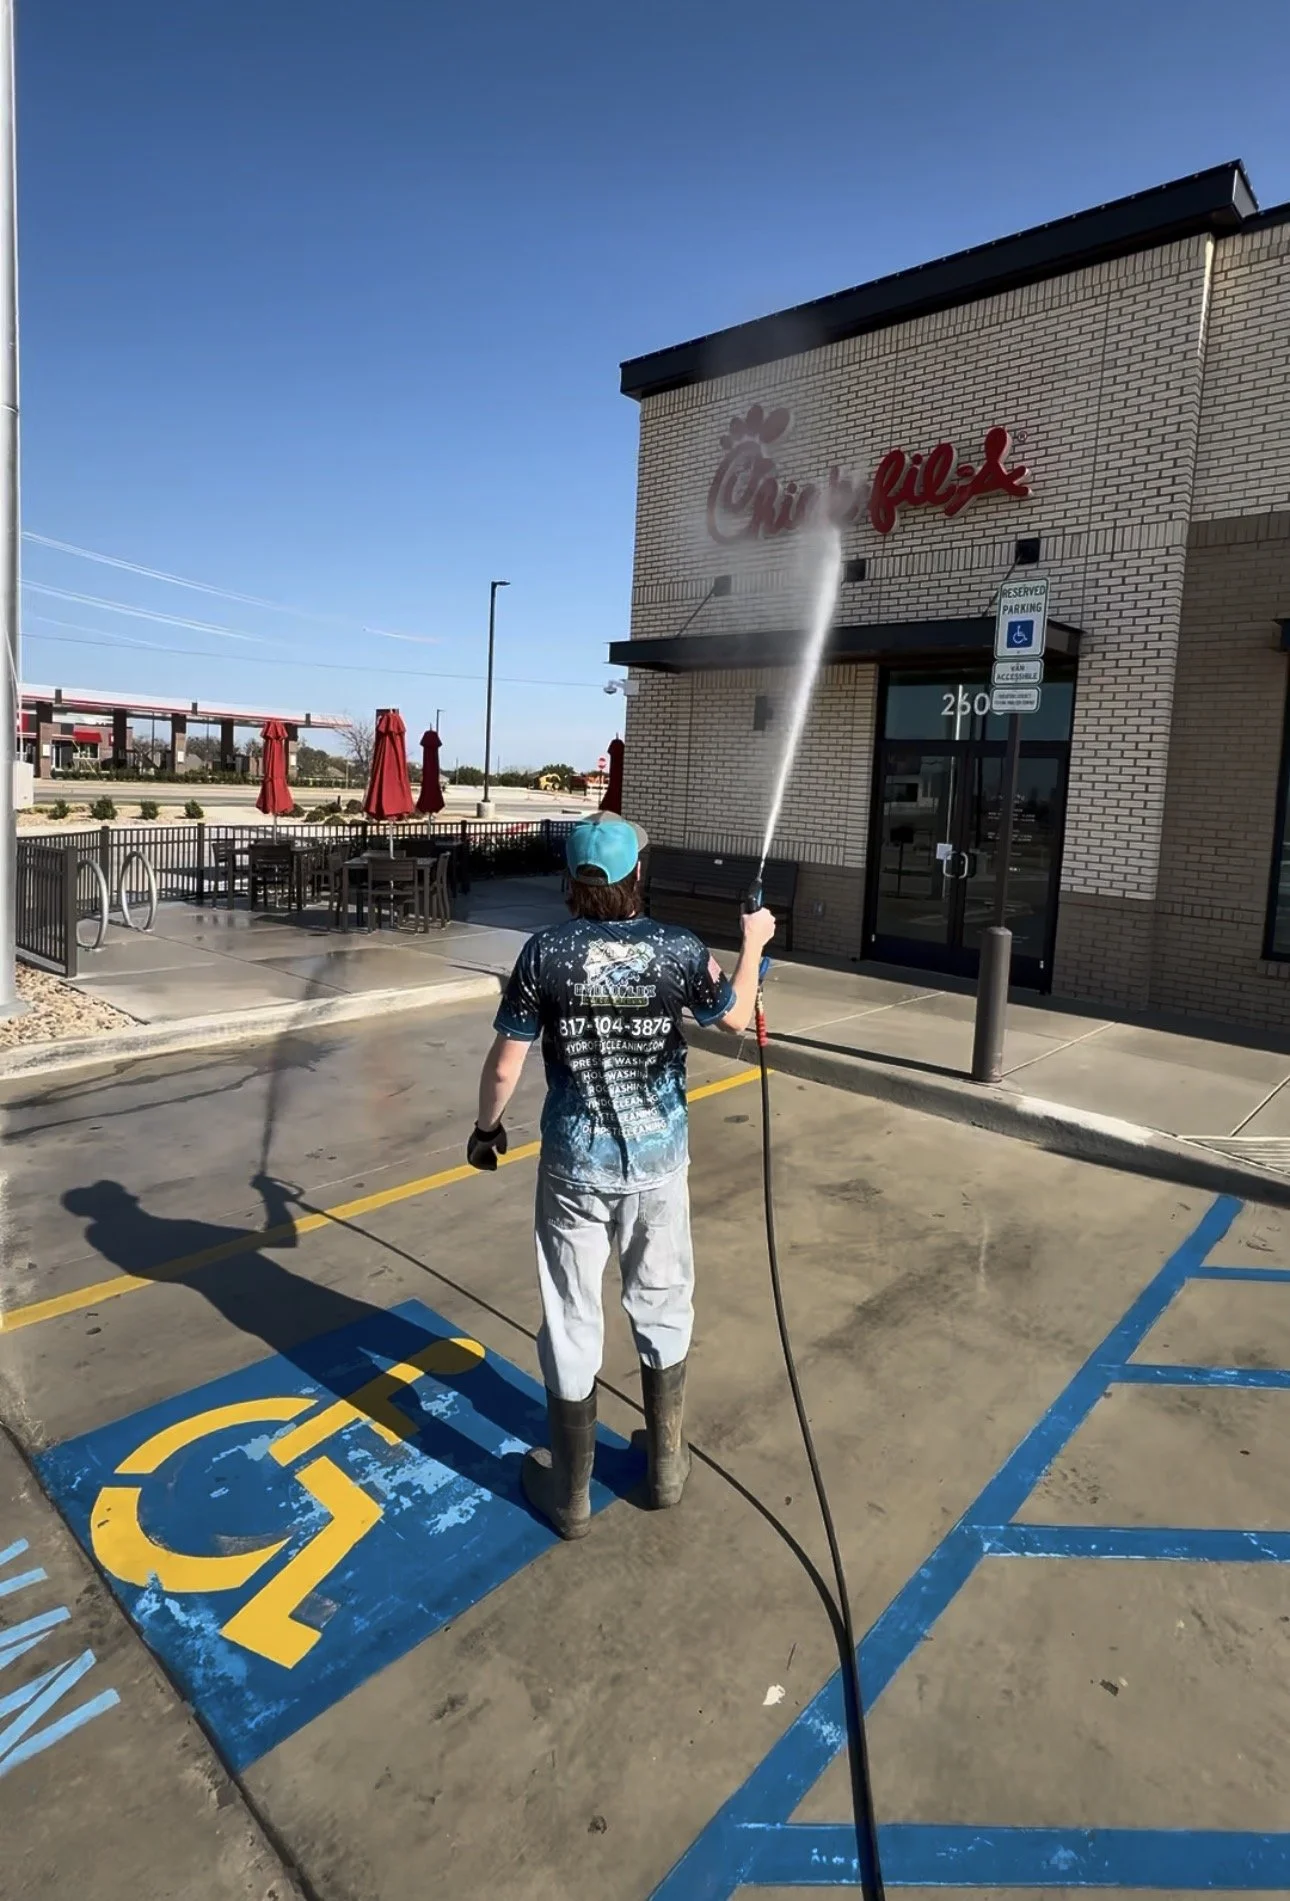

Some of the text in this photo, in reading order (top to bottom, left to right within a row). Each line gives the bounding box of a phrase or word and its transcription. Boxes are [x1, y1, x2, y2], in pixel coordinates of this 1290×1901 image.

[1001, 585, 1046, 598] RESERVED
[1002, 602, 1043, 615] PARKING
[941, 692, 1004, 716] 260
